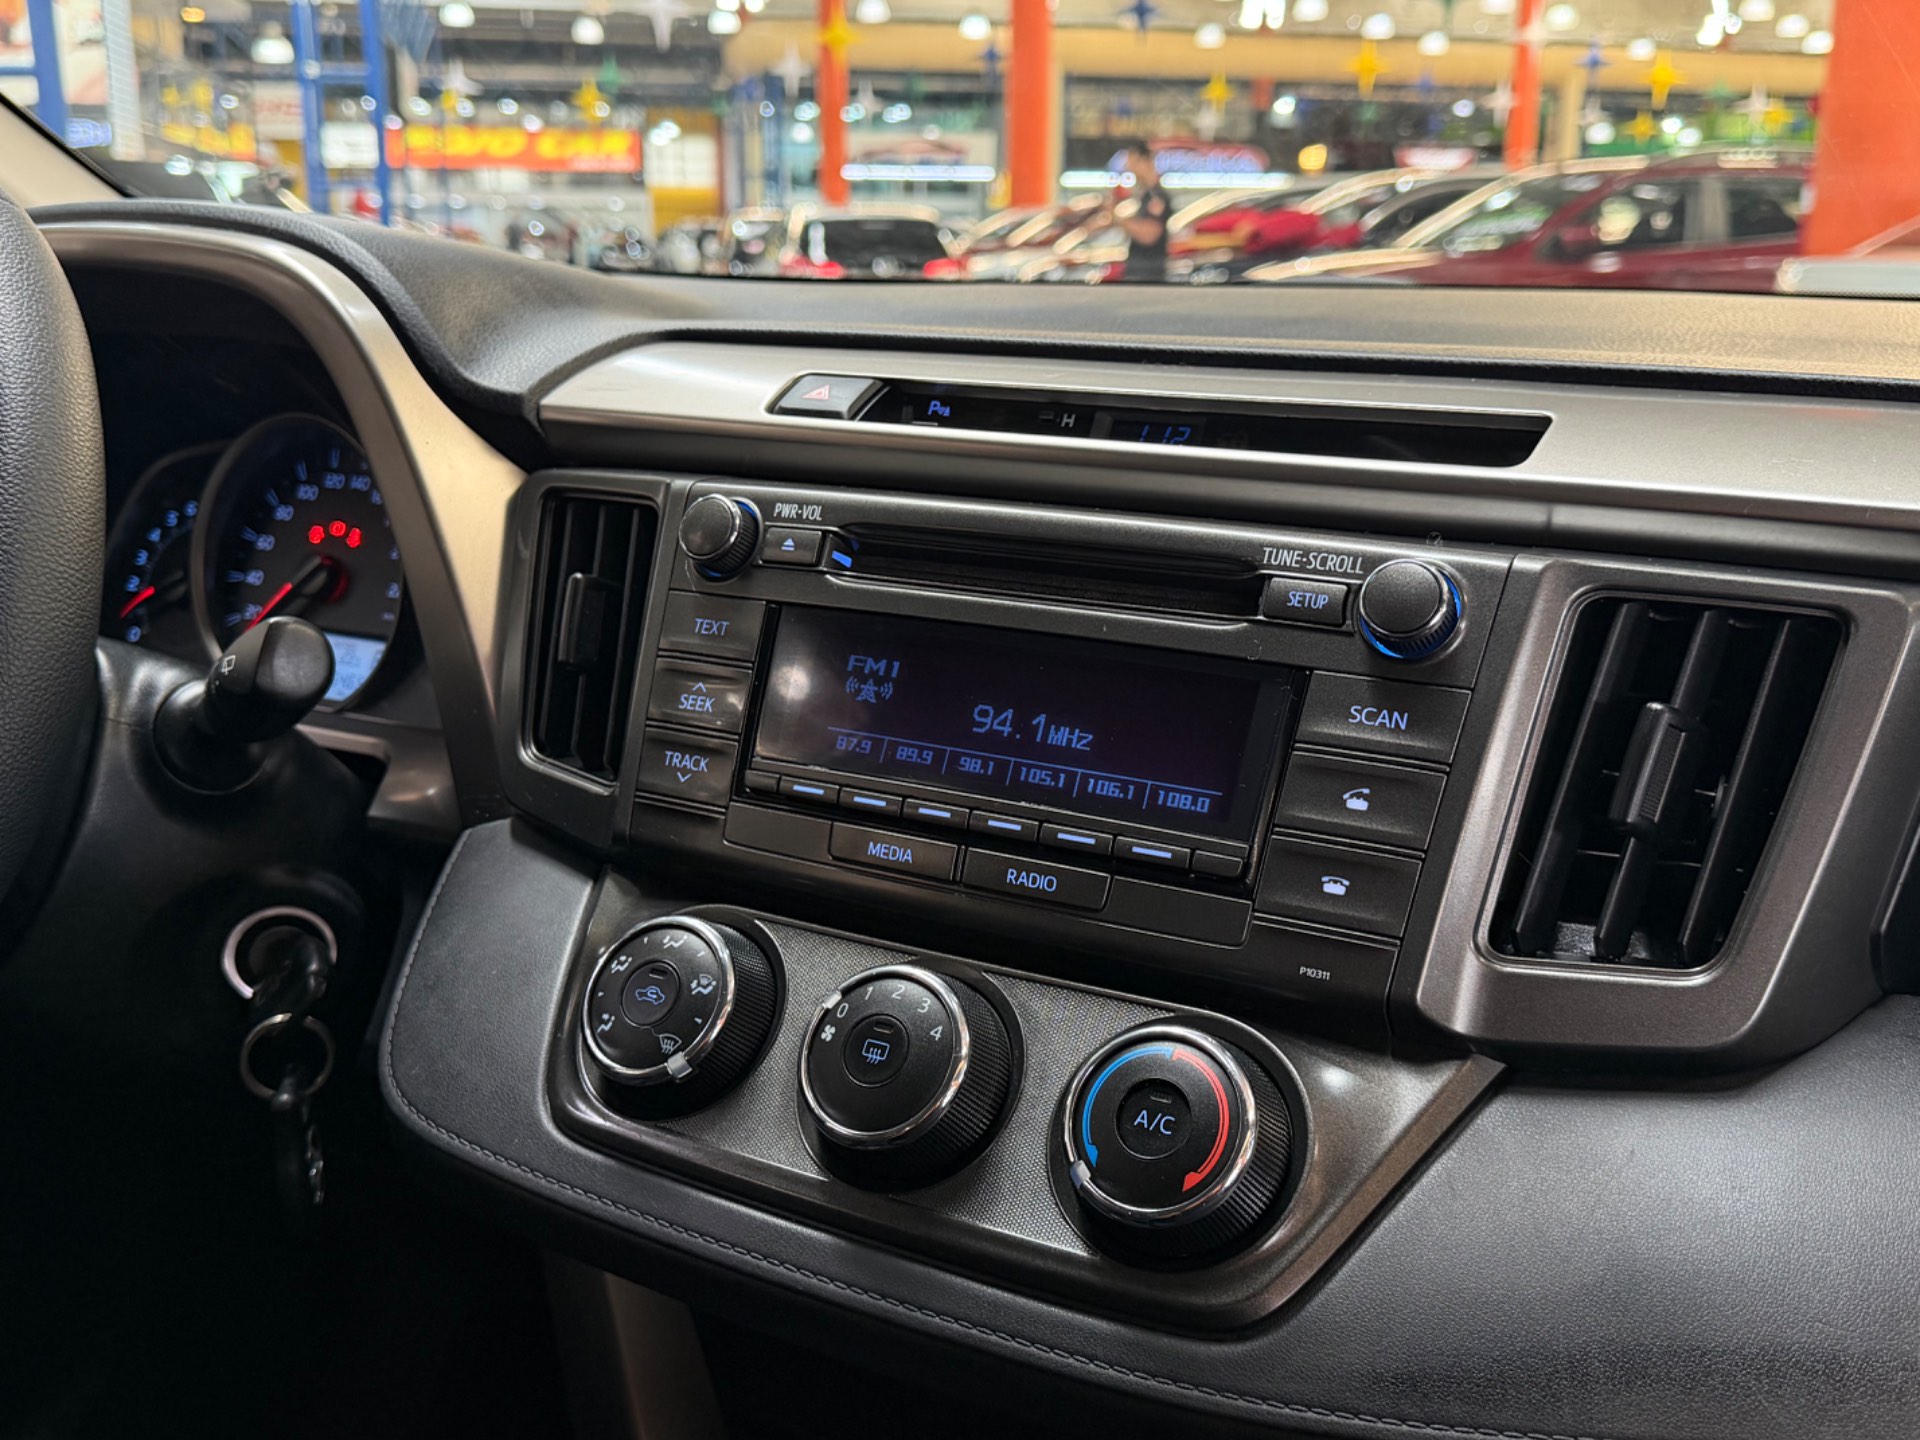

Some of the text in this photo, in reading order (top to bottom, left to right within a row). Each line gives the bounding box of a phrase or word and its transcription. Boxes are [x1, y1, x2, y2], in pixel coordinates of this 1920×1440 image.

[1286, 590, 1329, 609] SETUP
[694, 618, 729, 636] TEXT
[678, 694, 714, 713] SEEK
[1348, 704, 1409, 731] SCAN
[836, 736, 872, 754] 87.9
[664, 751, 709, 772] TRACK
[896, 745, 934, 766] 89.9
[959, 757, 995, 777] 98.1
[1020, 766, 1067, 789] 105.1
[1087, 778, 1135, 801] 106.1
[1157, 789, 1211, 814] 108.0
[867, 841, 914, 865] MEDIA
[1006, 868, 1058, 893] RADIO
[1300, 966, 1331, 981] P10311
[864, 986, 873, 1000] 1
[891, 984, 905, 1000] 2
[836, 1002, 849, 1018] 0
[916, 997, 931, 1013] 3
[929, 1025, 944, 1041] 4
[1134, 1109, 1176, 1136] A/C
